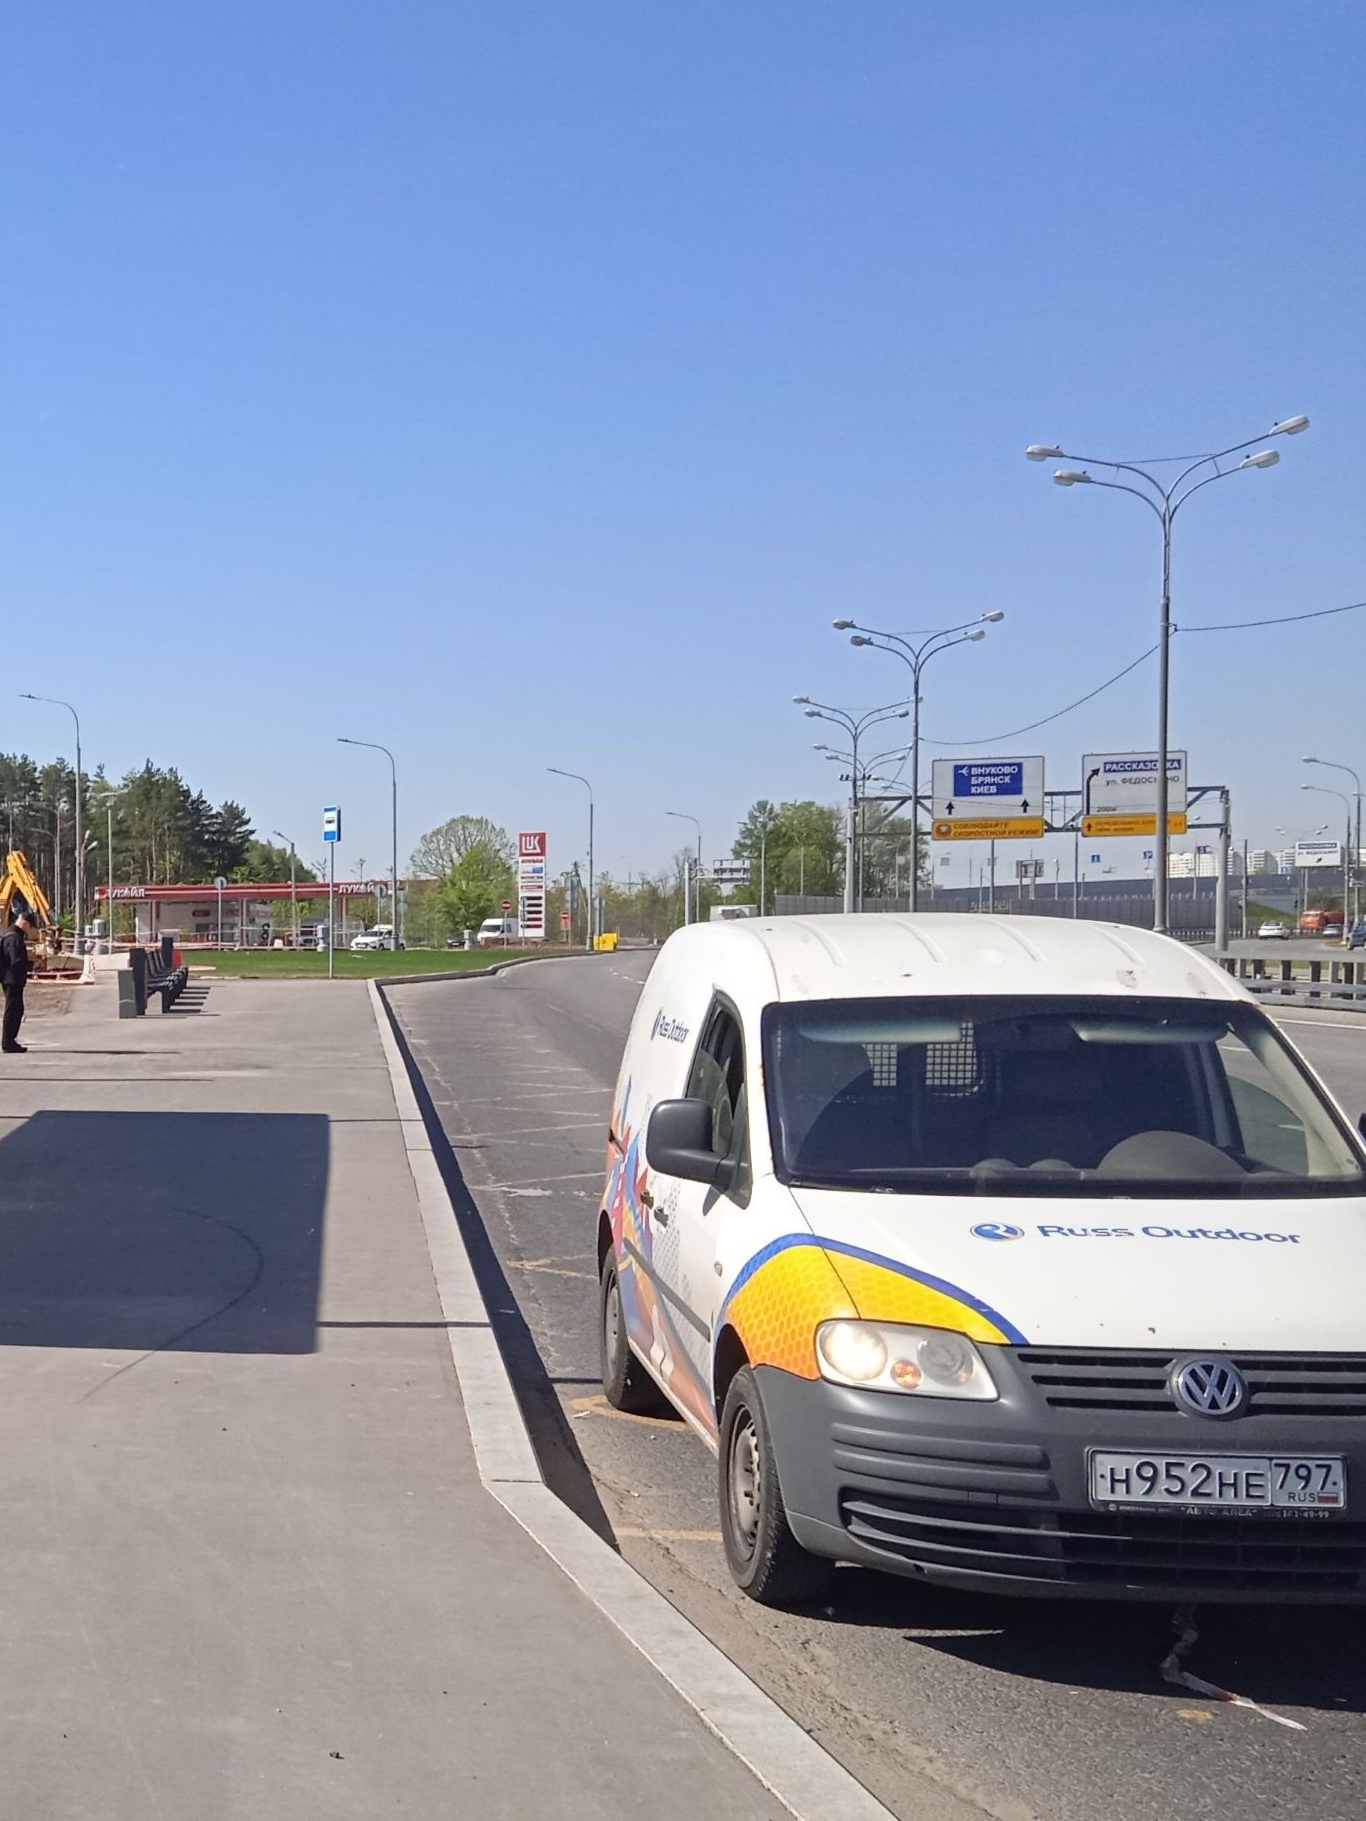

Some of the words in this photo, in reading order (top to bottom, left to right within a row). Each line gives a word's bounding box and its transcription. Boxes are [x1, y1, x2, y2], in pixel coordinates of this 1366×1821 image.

[971, 765, 1018, 775] ВНУКОВО
[1105, 761, 1180, 771] РАССКАЗОКА
[971, 775, 1011, 785] БРЯНСК
[971, 785, 997, 794] КИЕВ
[338, 882, 376, 894] ЛУКОЙ
[1036, 1225, 1135, 1238] Russ
[1141, 1226, 1301, 1244] Outdoor
[1273, 1462, 1333, 1491] 797
[1287, 1491, 1317, 1503] RUS
